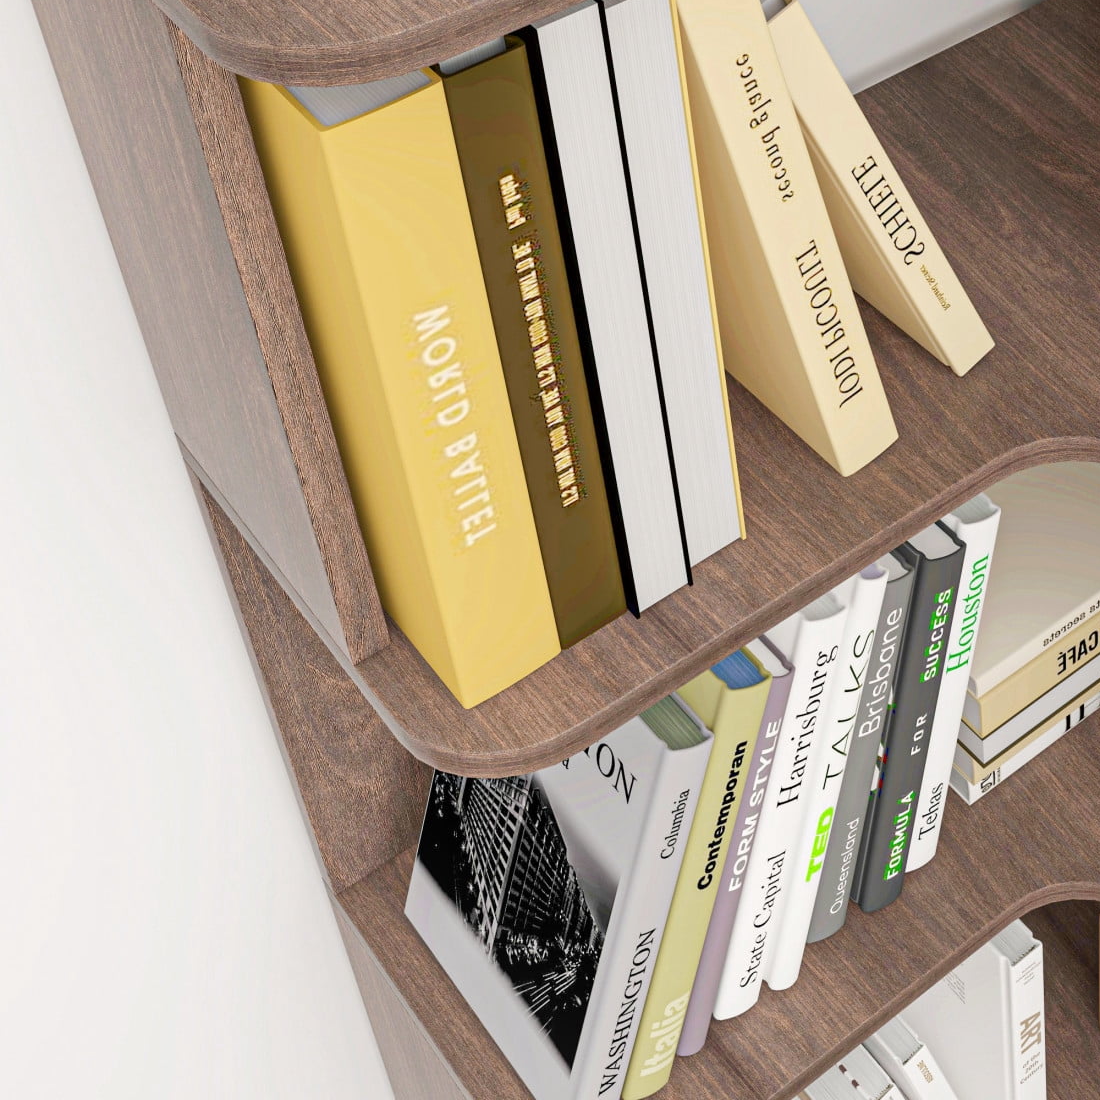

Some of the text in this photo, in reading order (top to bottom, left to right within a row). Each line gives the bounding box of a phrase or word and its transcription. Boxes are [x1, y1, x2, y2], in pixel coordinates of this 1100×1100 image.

[858, 607, 903, 740] Brisbane
[946, 554, 989, 675] Houston
[584, 744, 638, 805] ON
[777, 644, 839, 809] Harrisburg
[805, 629, 875, 883] TED TALKS
[884, 587, 953, 881] FORMULA FOR SUCCESS
[660, 789, 690, 859] Columbia
[728, 717, 782, 892] FORM STYLE
[829, 817, 860, 915] Queensland
[919, 782, 944, 840] Tehas
[740, 850, 787, 988] State Capital
[598, 928, 656, 1096] WASHINGTON
[640, 992, 690, 1077] Italia
[1020, 1011, 1042, 1055] ART
